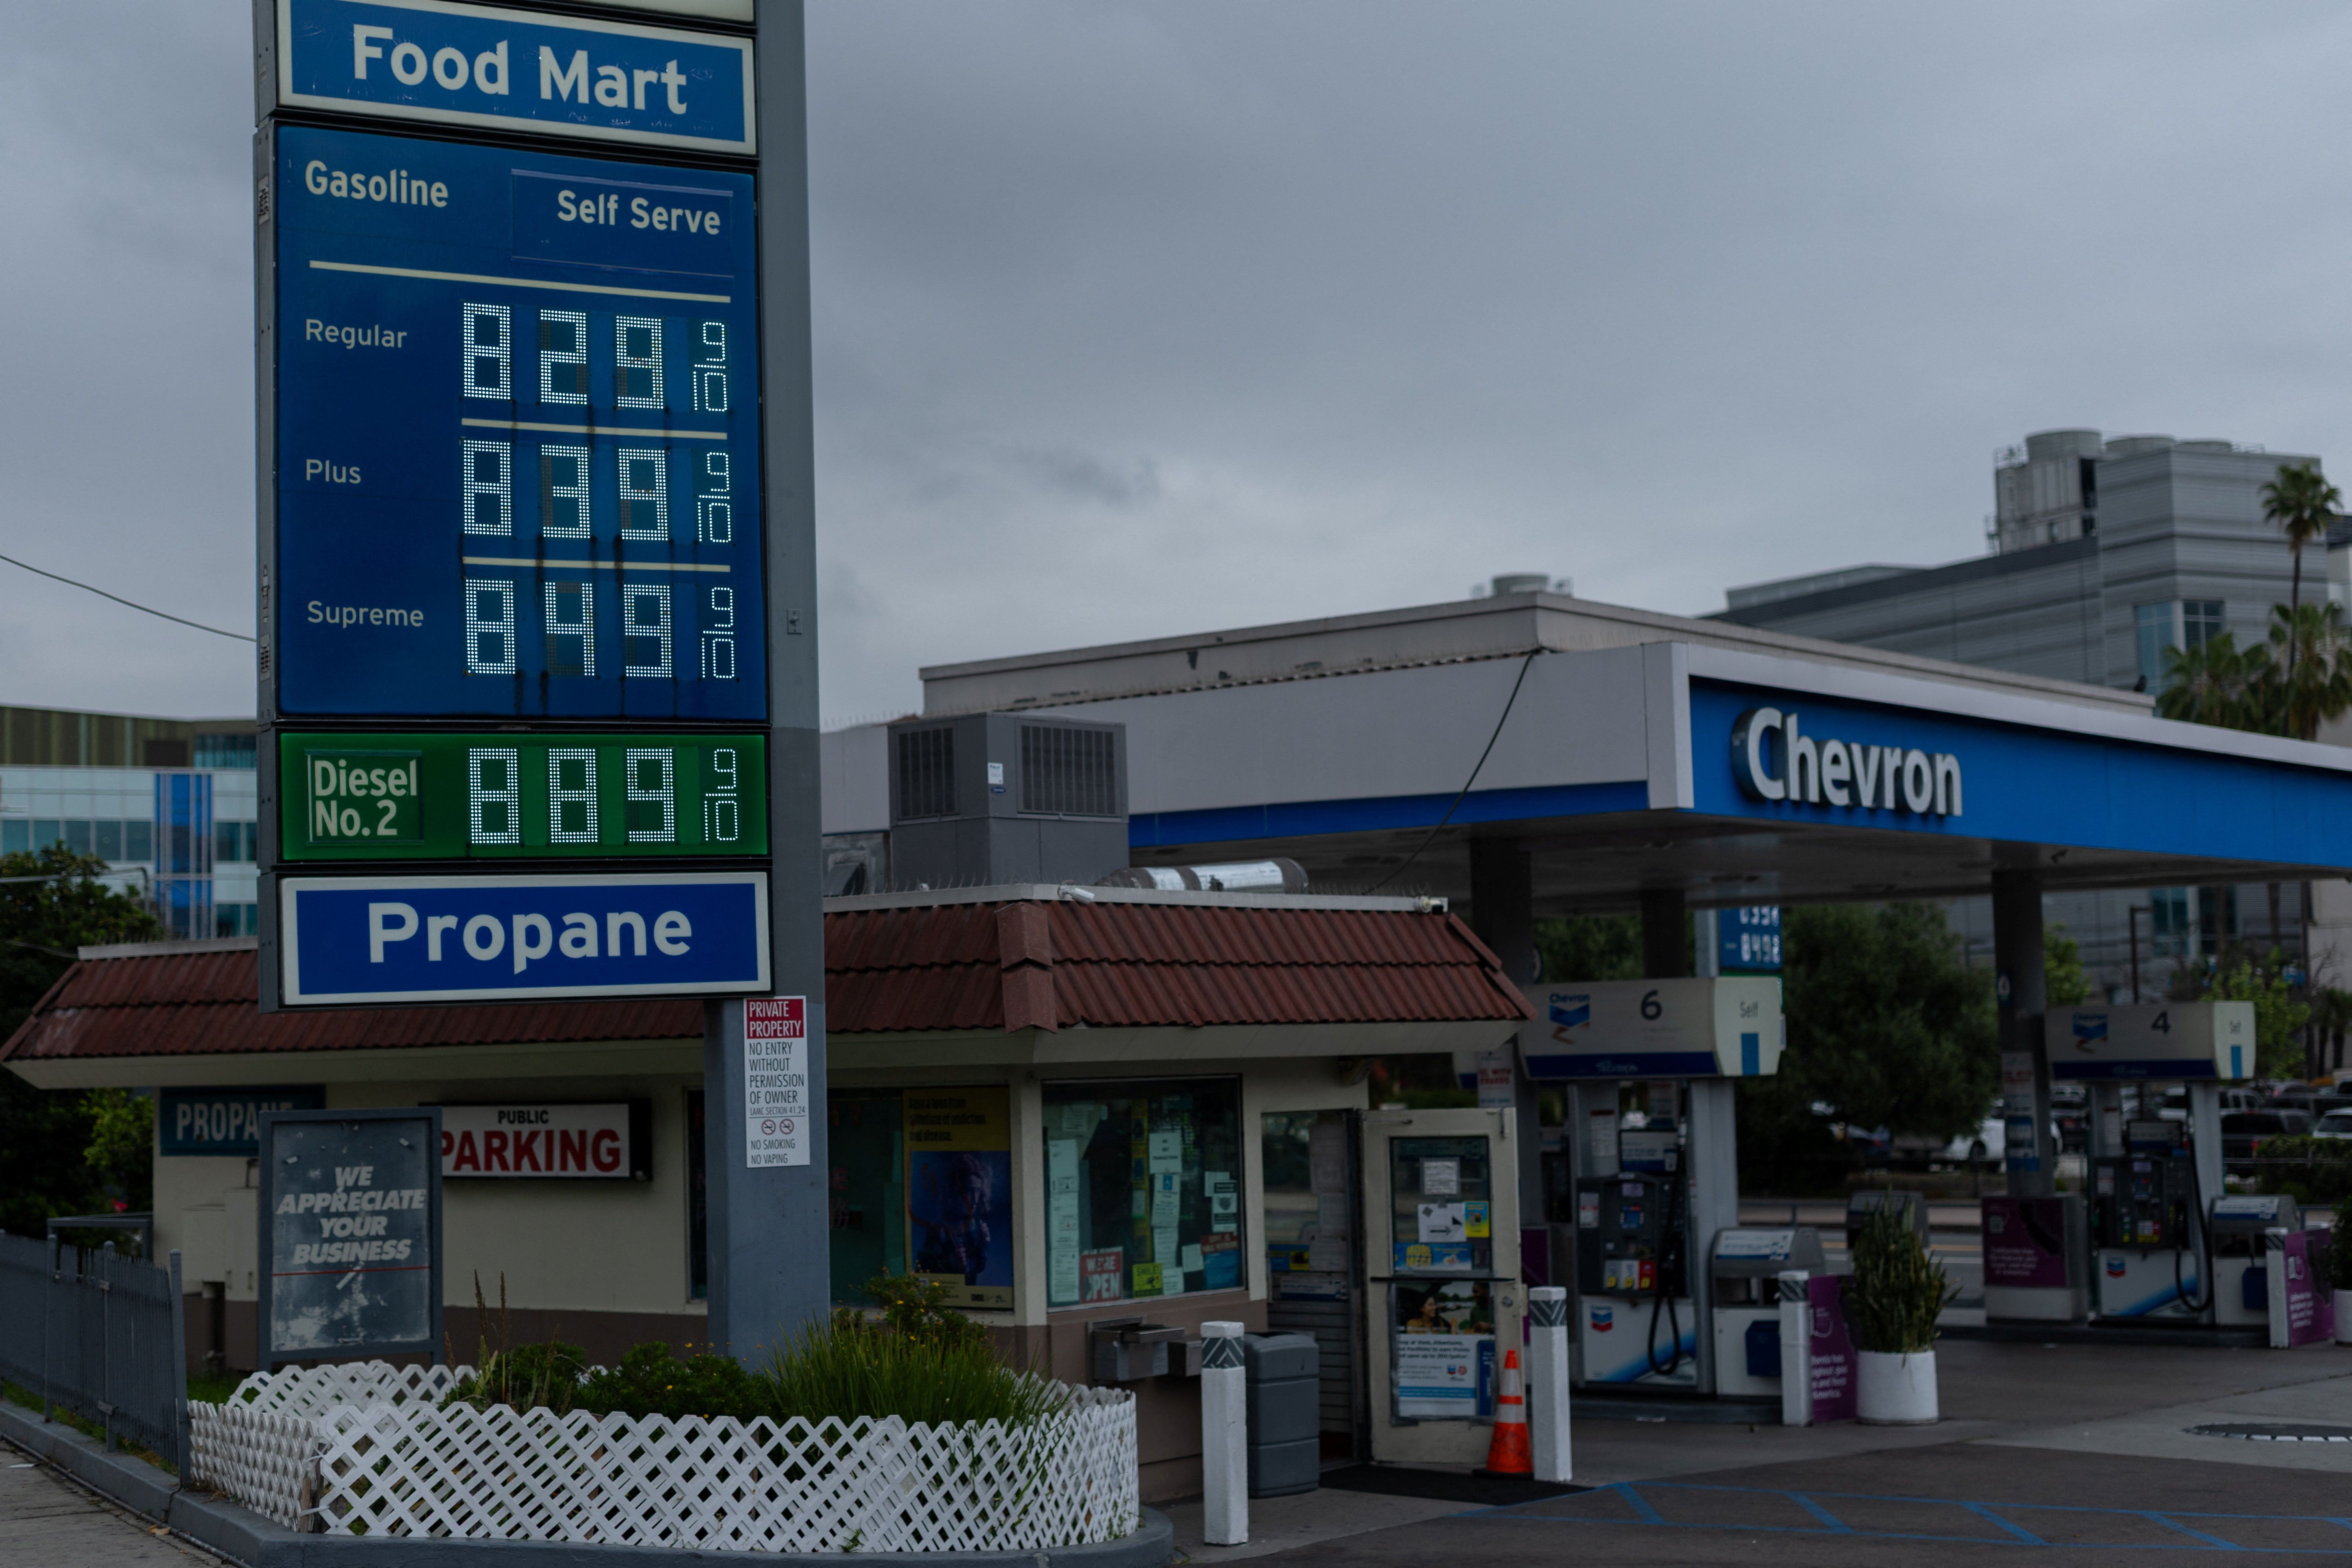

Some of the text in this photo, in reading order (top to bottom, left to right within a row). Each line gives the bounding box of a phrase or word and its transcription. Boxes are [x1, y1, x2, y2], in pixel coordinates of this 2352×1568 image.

[352, 24, 688, 115] Food Mart
[305, 159, 448, 208] Gasoline
[557, 189, 721, 235] Self Serve
[305, 318, 407, 350] Regular
[463, 302, 664, 409] 829
[305, 459, 361, 485] Plus
[462, 440, 668, 541] 839
[308, 601, 423, 628] Supreme
[465, 579, 672, 678] 849
[1741, 706, 1962, 816] Chevron
[314, 759, 417, 797] Diesel
[469, 747, 675, 844] 889
[369, 902, 692, 974] Propane
[749, 1001, 789, 1017] PRIVATE
[1549, 993, 1590, 1003] Chevron
[1641, 990, 1662, 1020] 6
[1740, 1000, 1759, 1018] Self
[749, 1020, 801, 1037] PROPERTY
[2151, 1010, 2170, 1035] 4
[749, 1042, 792, 1055] NO ENTRY
[749, 1058, 790, 1071] WITHOUT
[750, 1074, 804, 1088] PERMISSION
[750, 1090, 798, 1104] OF OWNER
[176, 1101, 294, 1141] PROPA
[498, 1110, 549, 1124] PUBLIC
[750, 1106, 805, 1116] LAMC SECTION 41.24
[951, 1114, 985, 1125] addiction
[751, 1139, 795, 1150] NO SMOKING
[751, 1153, 788, 1165] NO VAPING
[335, 1165, 375, 1187] WE
[276, 1189, 427, 1215] APPRECIATE
[320, 1215, 387, 1239] YOUR
[293, 1238, 412, 1264] BUSINESS
[1085, 1256, 1116, 1272] WE'RE
[1084, 1272, 1120, 1301] OPEN
